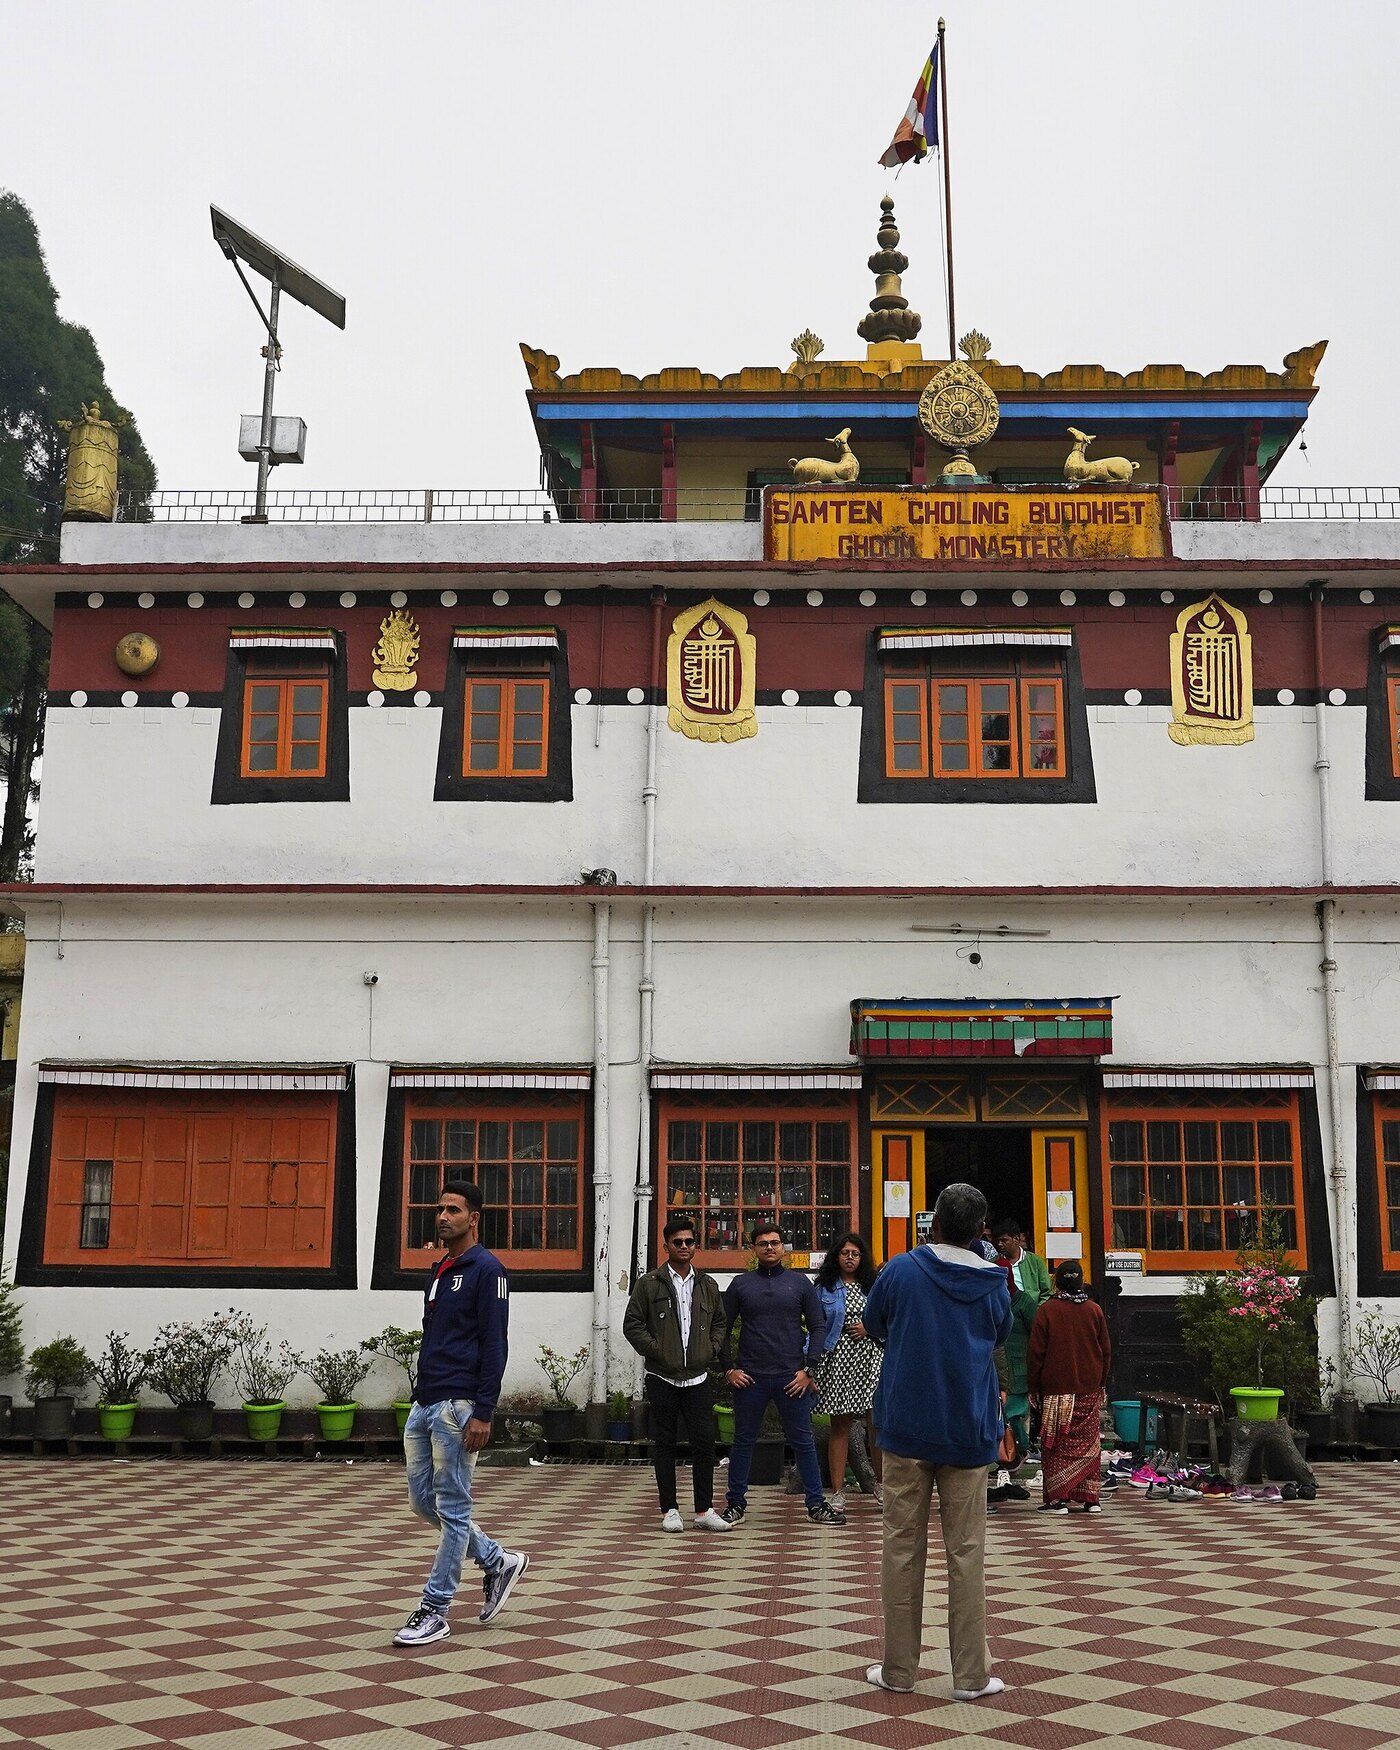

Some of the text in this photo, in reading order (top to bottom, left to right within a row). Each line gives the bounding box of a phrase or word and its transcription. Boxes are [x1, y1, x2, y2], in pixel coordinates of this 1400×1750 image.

[773, 500, 1146, 525] SAMTEN CHOLING BUDDHIST
[838, 535, 1078, 559] GHOOM MONASTERY
